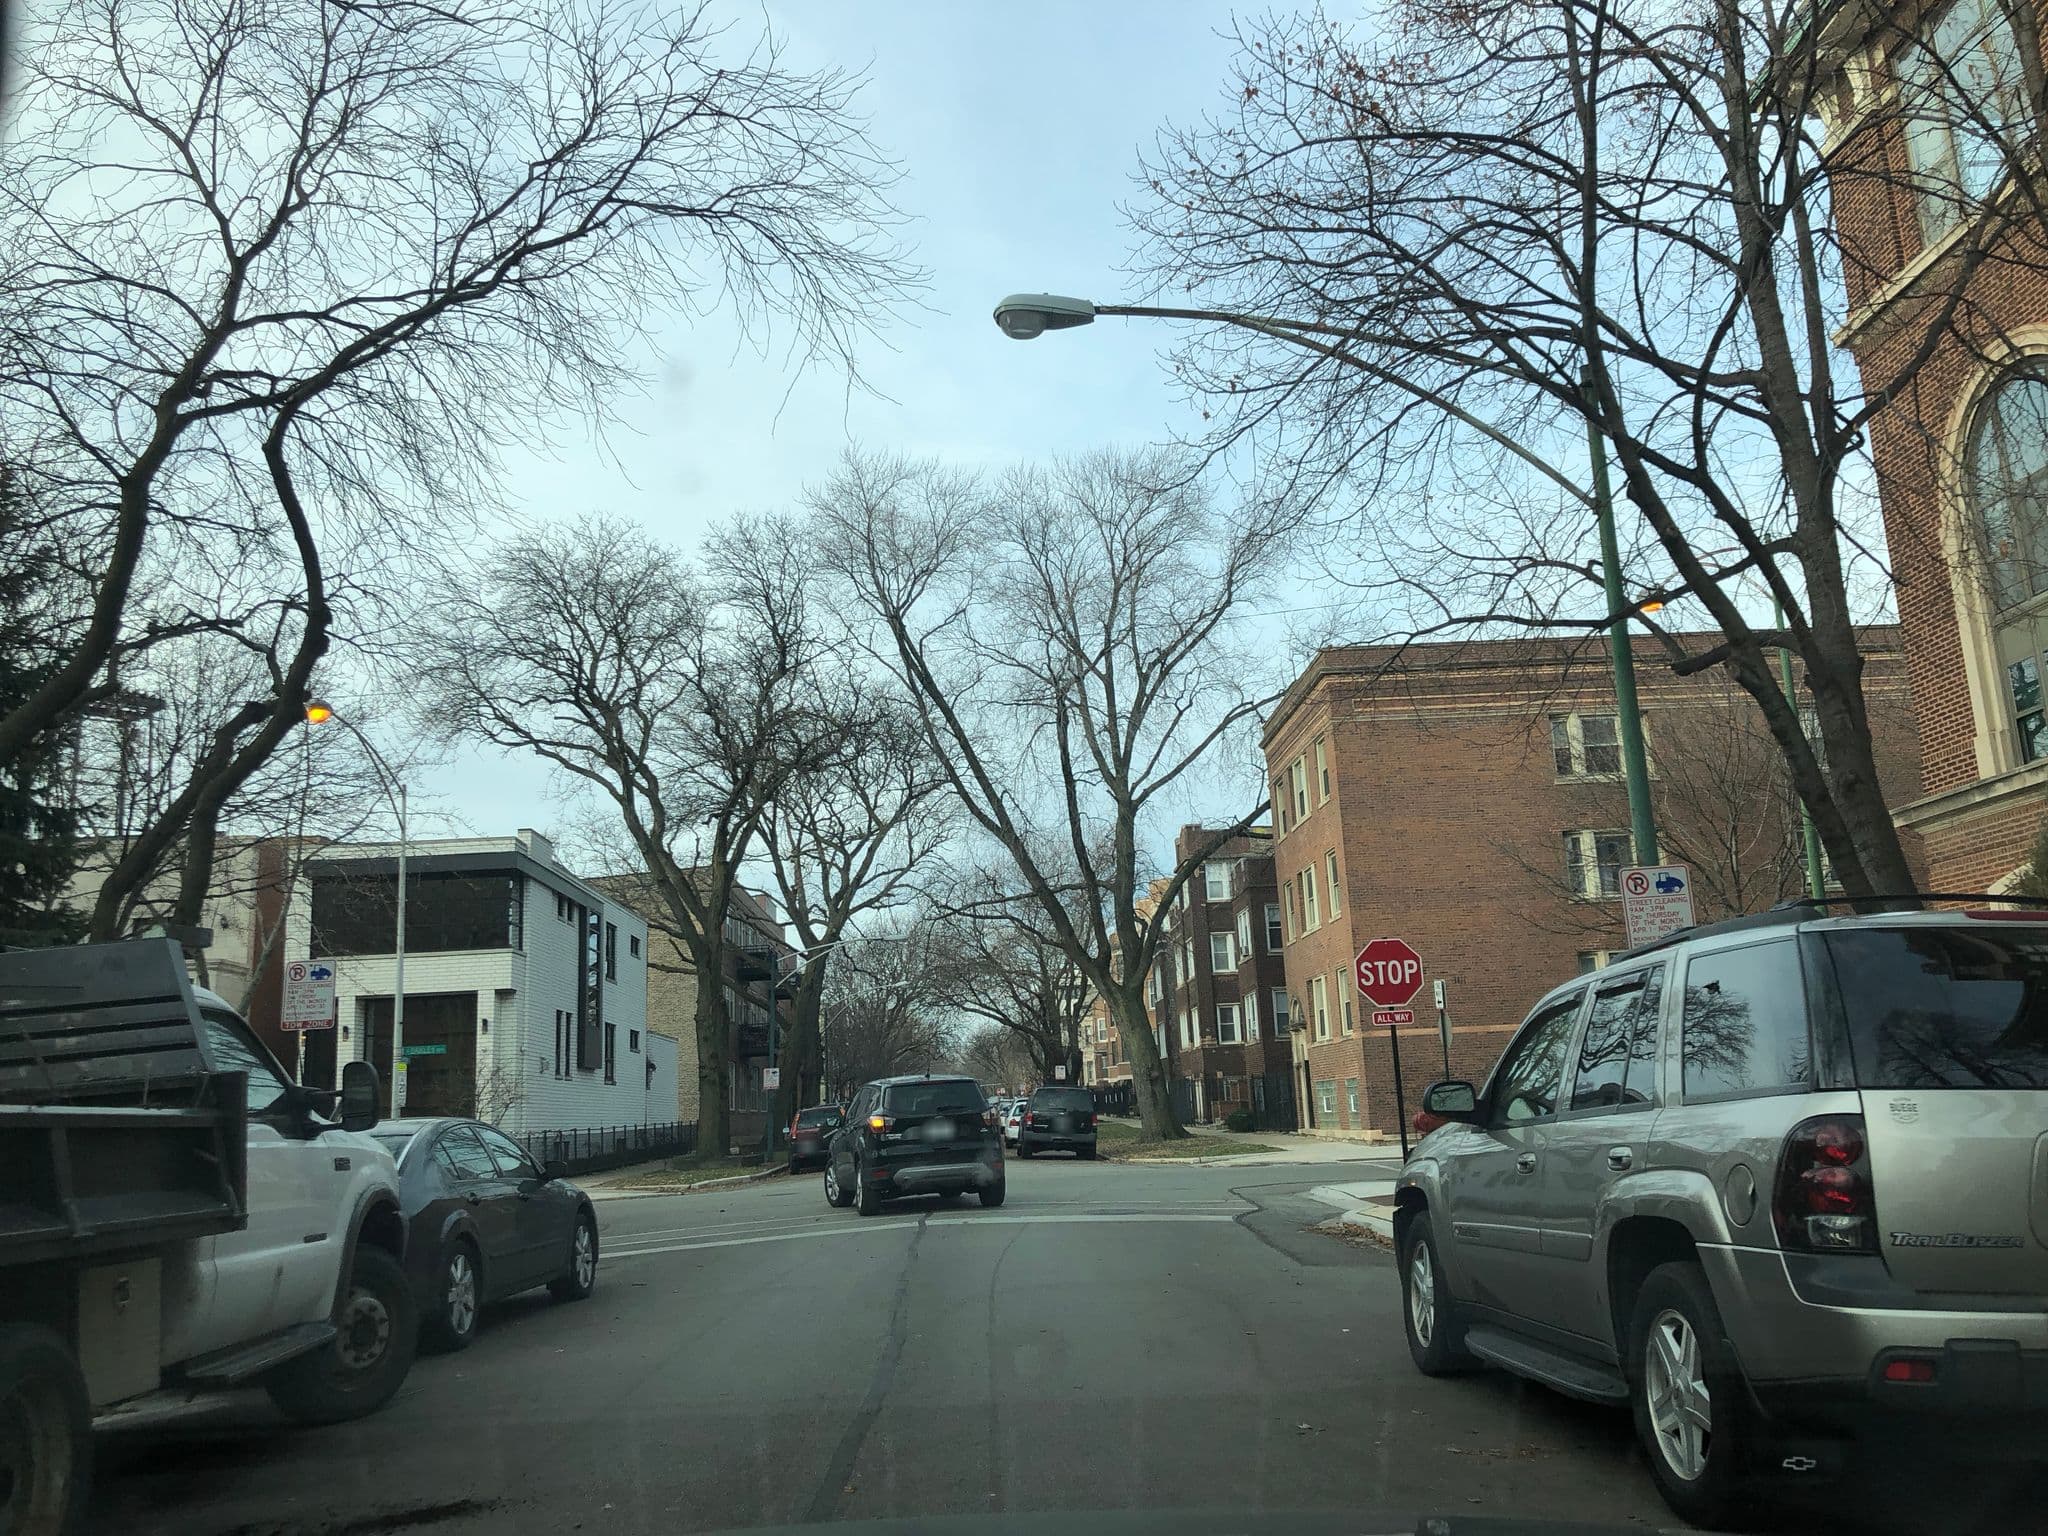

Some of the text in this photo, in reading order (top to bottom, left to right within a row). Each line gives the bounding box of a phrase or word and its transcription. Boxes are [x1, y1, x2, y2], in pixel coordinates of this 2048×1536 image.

[1654, 896, 1688, 905] CLEANING
[1646, 911, 1680, 919] THURSDAY
[1660, 917, 1684, 925] MONTH
[1360, 959, 1418, 986] STOP
[1377, 1012, 1411, 1023] ALL WAY
[307, 1020, 330, 1028] ZONE
